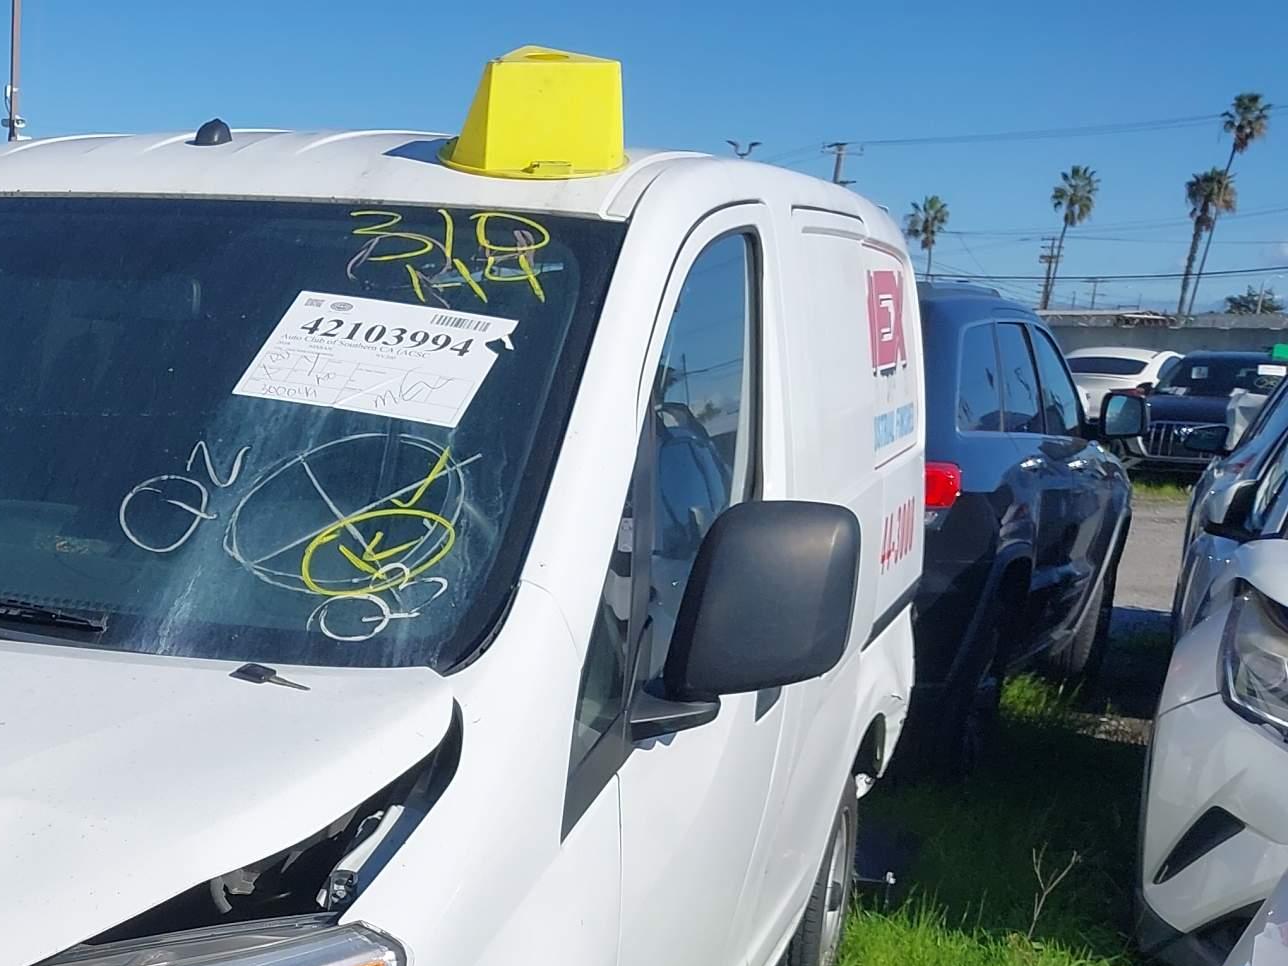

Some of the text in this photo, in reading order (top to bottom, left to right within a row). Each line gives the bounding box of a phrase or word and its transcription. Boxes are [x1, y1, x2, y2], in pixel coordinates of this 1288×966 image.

[280, 333, 302, 342] Auto
[304, 335, 326, 344] Club
[339, 340, 377, 352] Southern
[300, 316, 475, 357] 42103994
